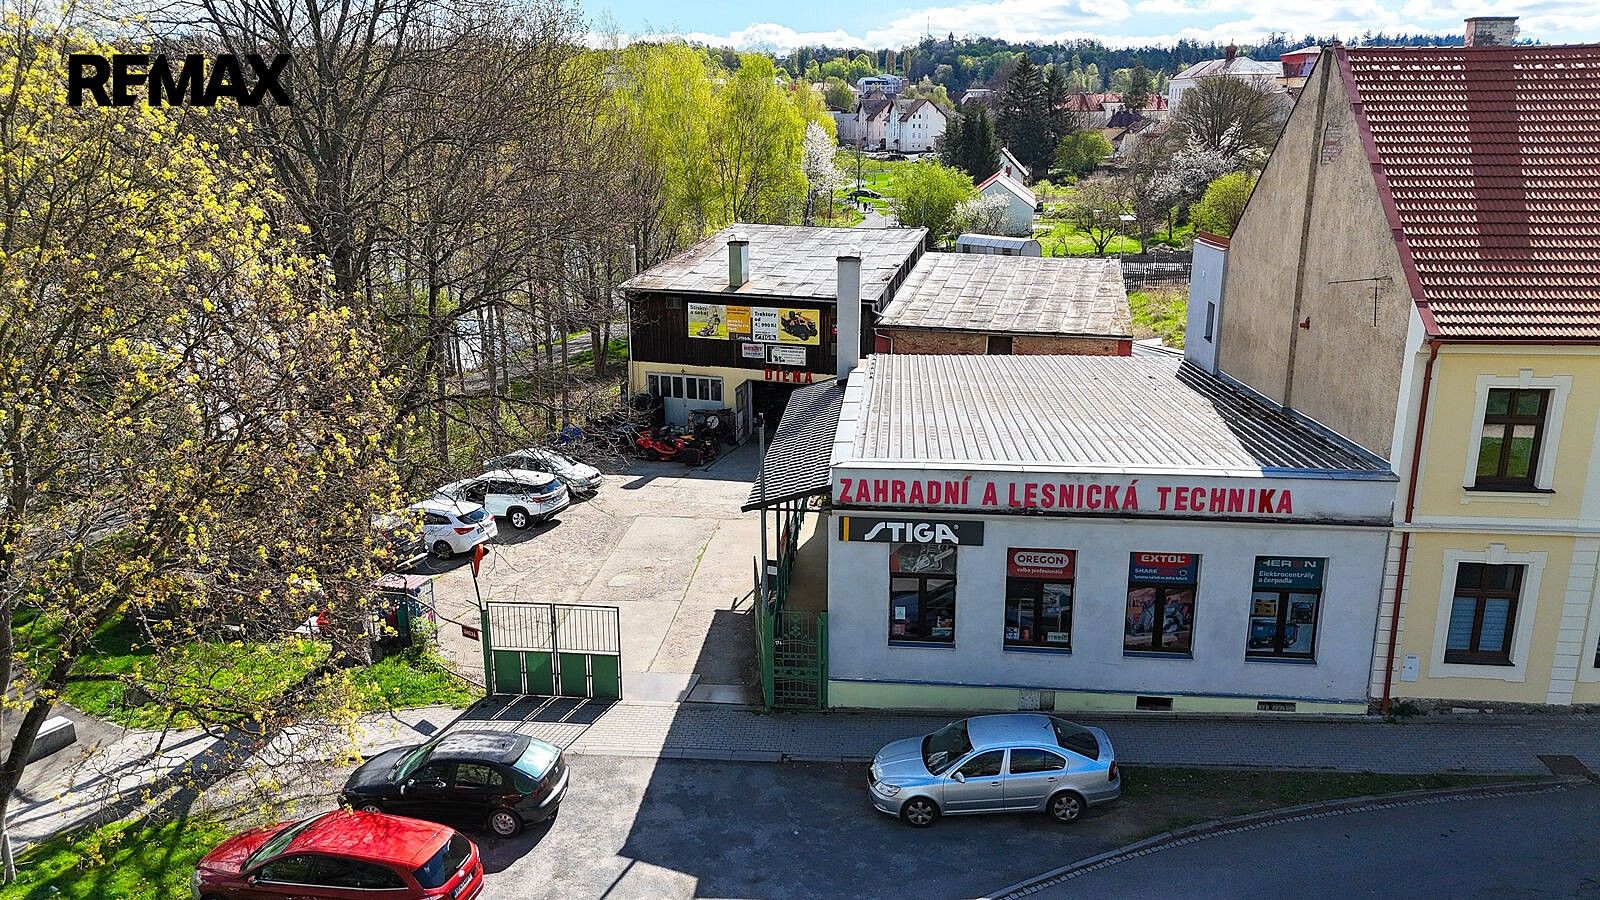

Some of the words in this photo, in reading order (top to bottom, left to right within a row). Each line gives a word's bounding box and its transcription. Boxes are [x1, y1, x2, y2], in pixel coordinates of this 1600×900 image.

[839, 475, 972, 505] ZAHRADNÍ
[982, 482, 998, 505] A
[1008, 479, 1139, 510] LESNICKÁ
[1157, 486, 1293, 513] TECHNIKA
[864, 521, 959, 544] STIGA
[1017, 554, 1064, 565] OREGON
[1141, 554, 1185, 563] EXTOL
[1258, 570, 1315, 580] Elektrocentrály
